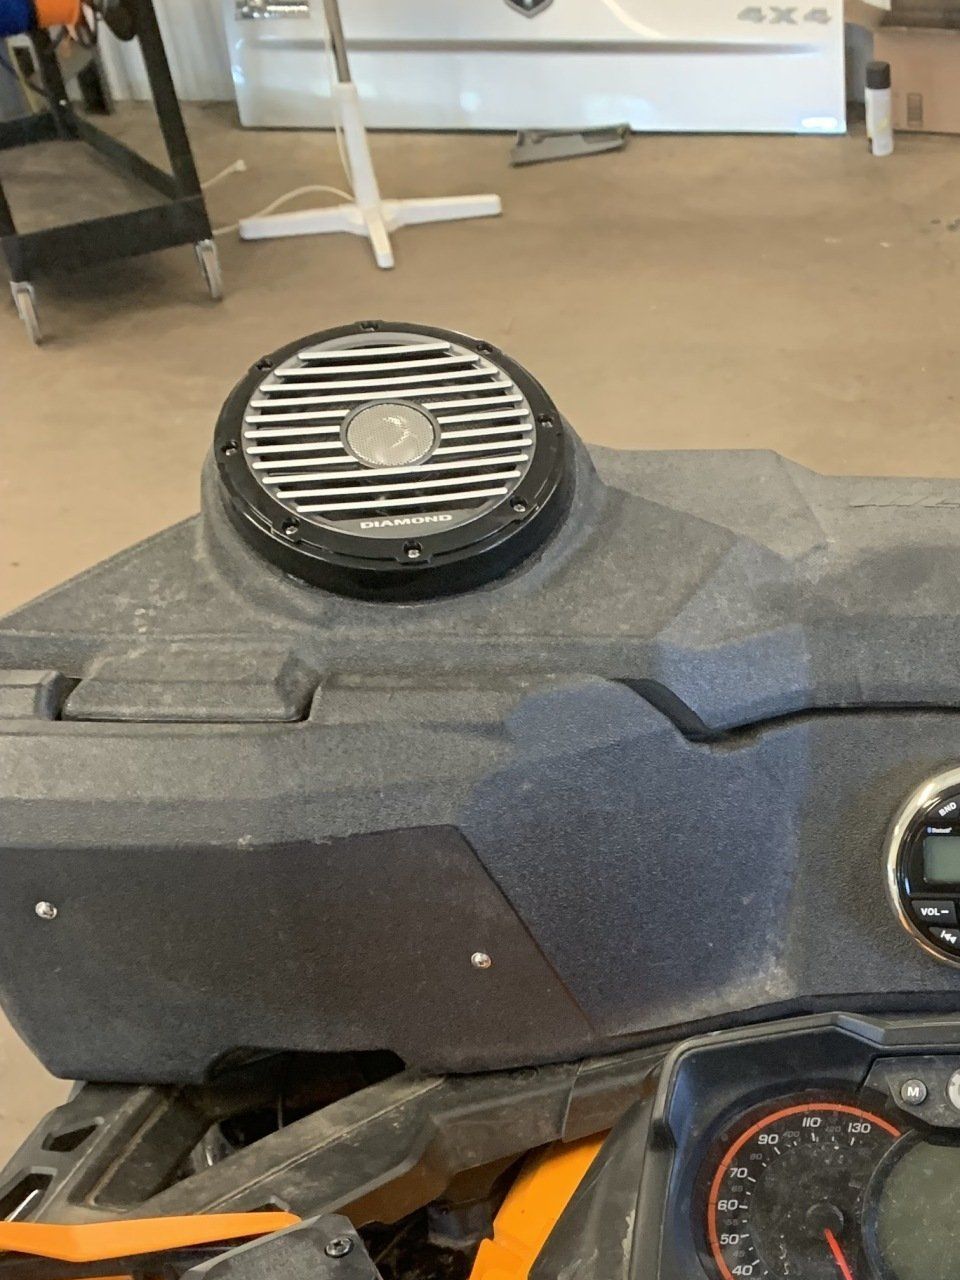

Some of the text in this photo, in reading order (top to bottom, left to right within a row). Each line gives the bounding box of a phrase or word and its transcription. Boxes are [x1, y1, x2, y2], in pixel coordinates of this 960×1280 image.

[360, 514, 453, 529] DIAMOND
[938, 801, 958, 817] BND
[907, 1086, 920, 1098] M
[802, 1116, 822, 1128] 110
[847, 1122, 872, 1134] 130
[758, 1133, 779, 1145] 90
[730, 1167, 748, 1179] 70
[717, 1199, 739, 1211] 60
[719, 1233, 740, 1246] 50
[731, 1264, 754, 1276] 40
